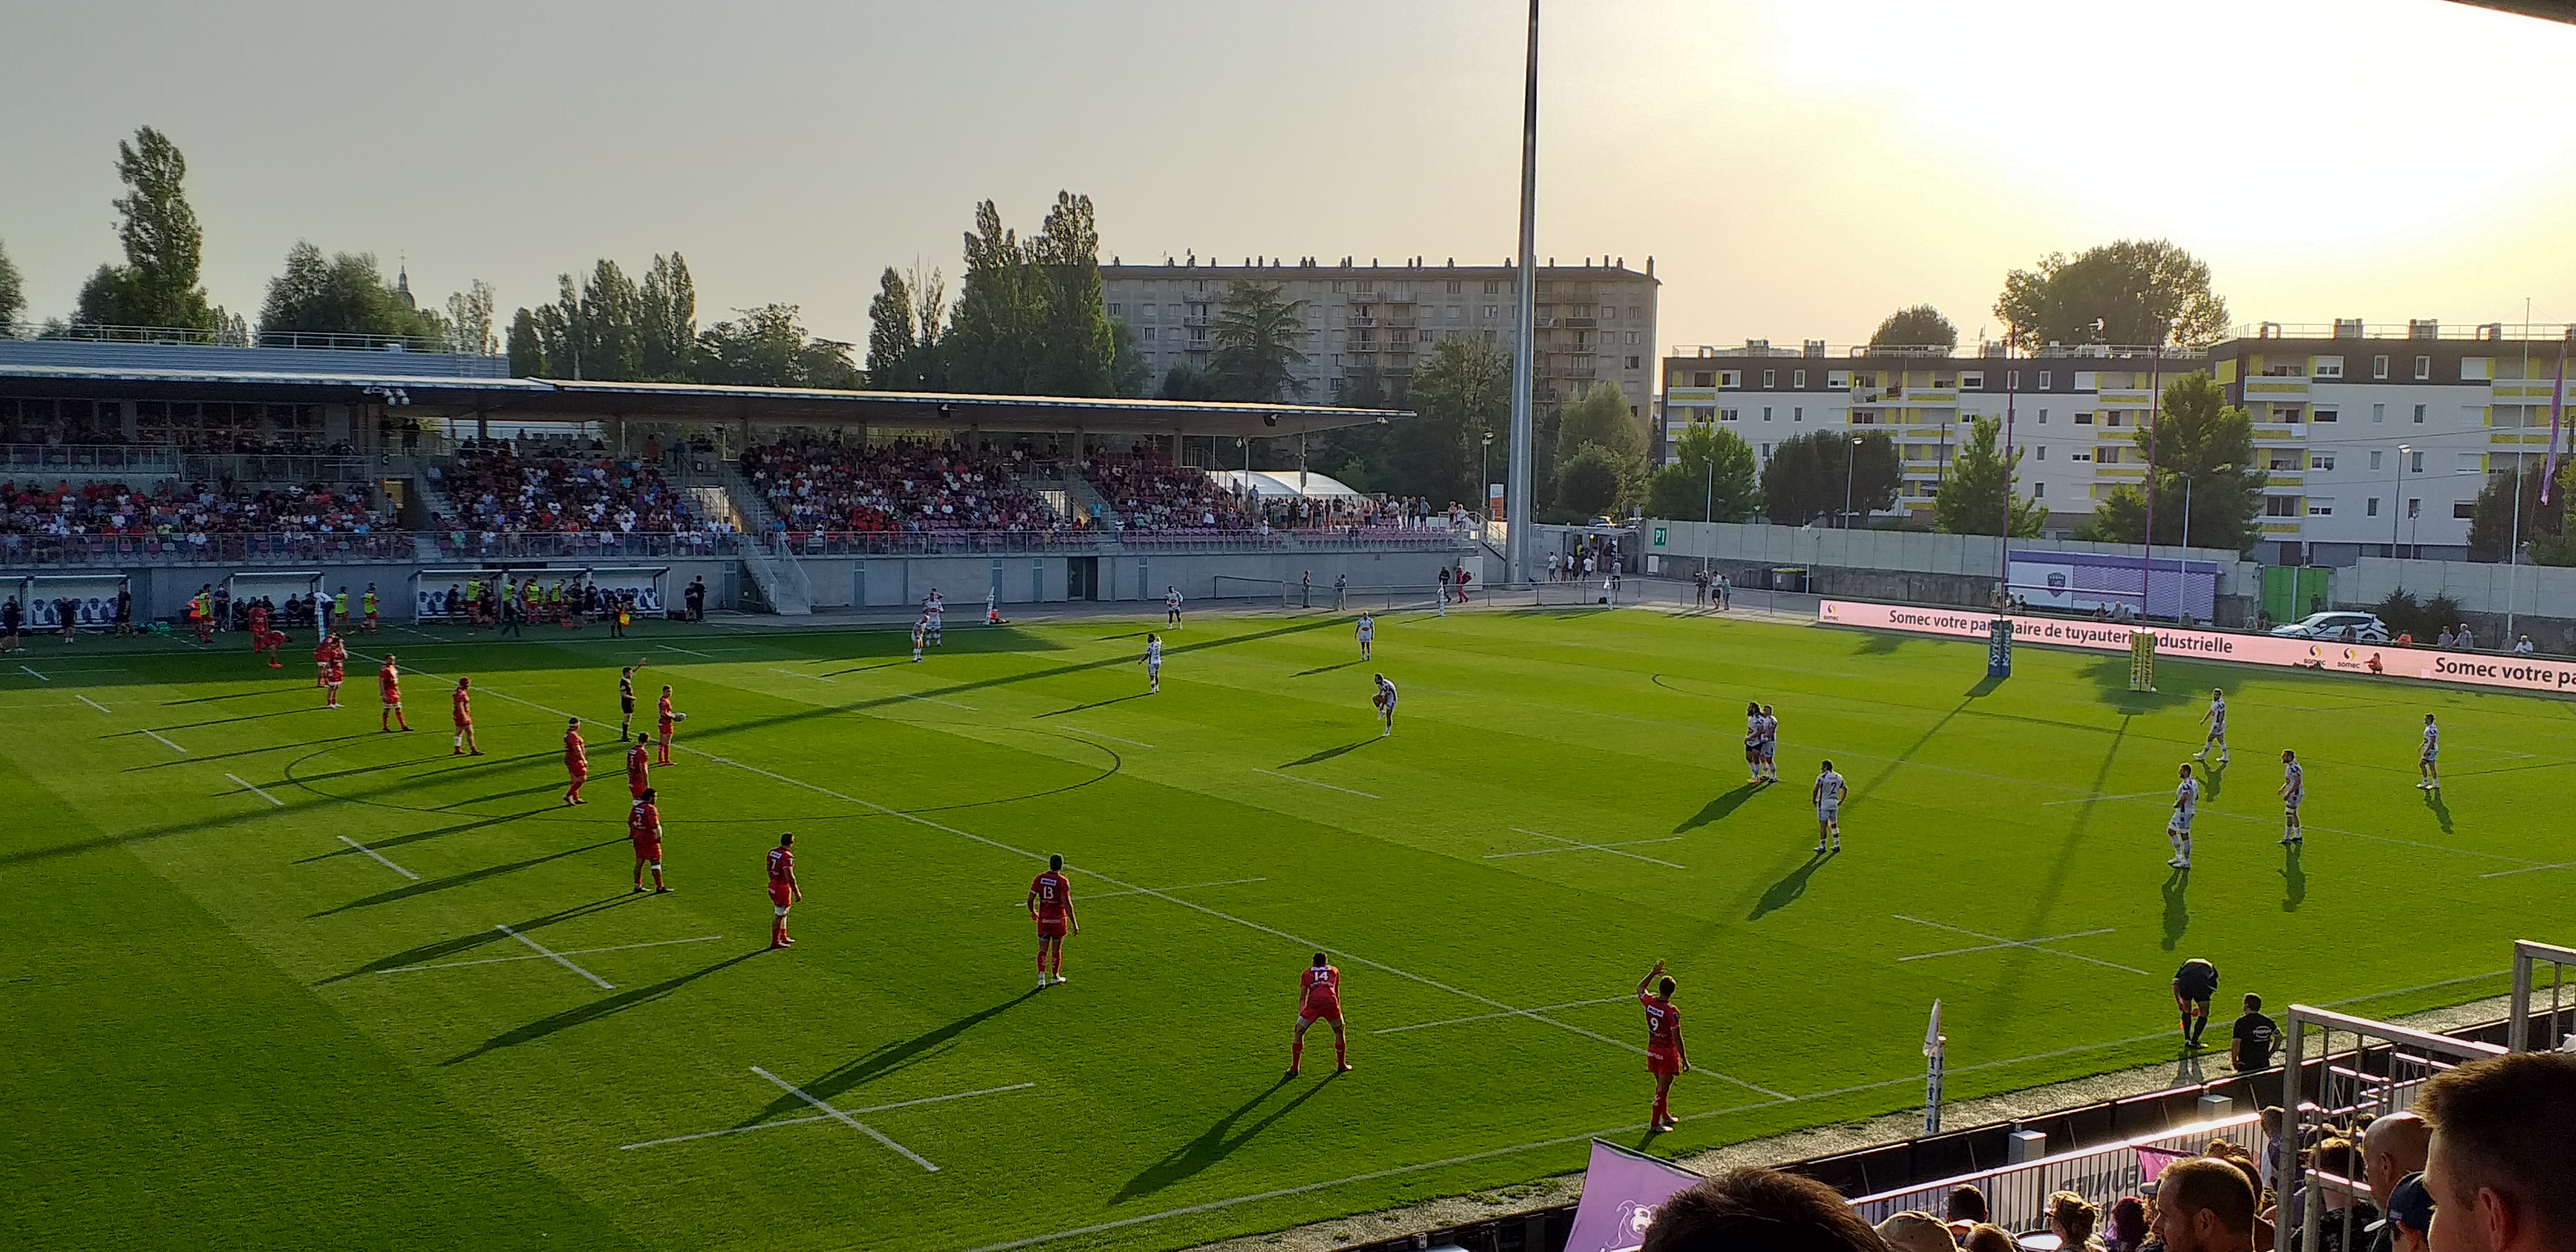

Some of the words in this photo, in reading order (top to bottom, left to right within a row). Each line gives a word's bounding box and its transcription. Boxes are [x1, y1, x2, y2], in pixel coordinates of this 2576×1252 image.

[1655, 530, 1666, 543] P1
[1889, 609, 1931, 626] Somec
[1934, 616, 1968, 629] votre
[2044, 623, 2062, 634] de
[2066, 625, 2133, 645] tuyauteri
[1989, 629, 2000, 667] Kyriad
[2002, 629, 2011, 666] Kyriad
[2435, 657, 2497, 678] Somec
[2502, 666, 2553, 682] votre
[1830, 782, 1837, 794] 2
[771, 859, 777, 869] 7
[1043, 886, 1054, 899] 13
[1314, 971, 1329, 981] 14
[1650, 1017, 1659, 1032] 9
